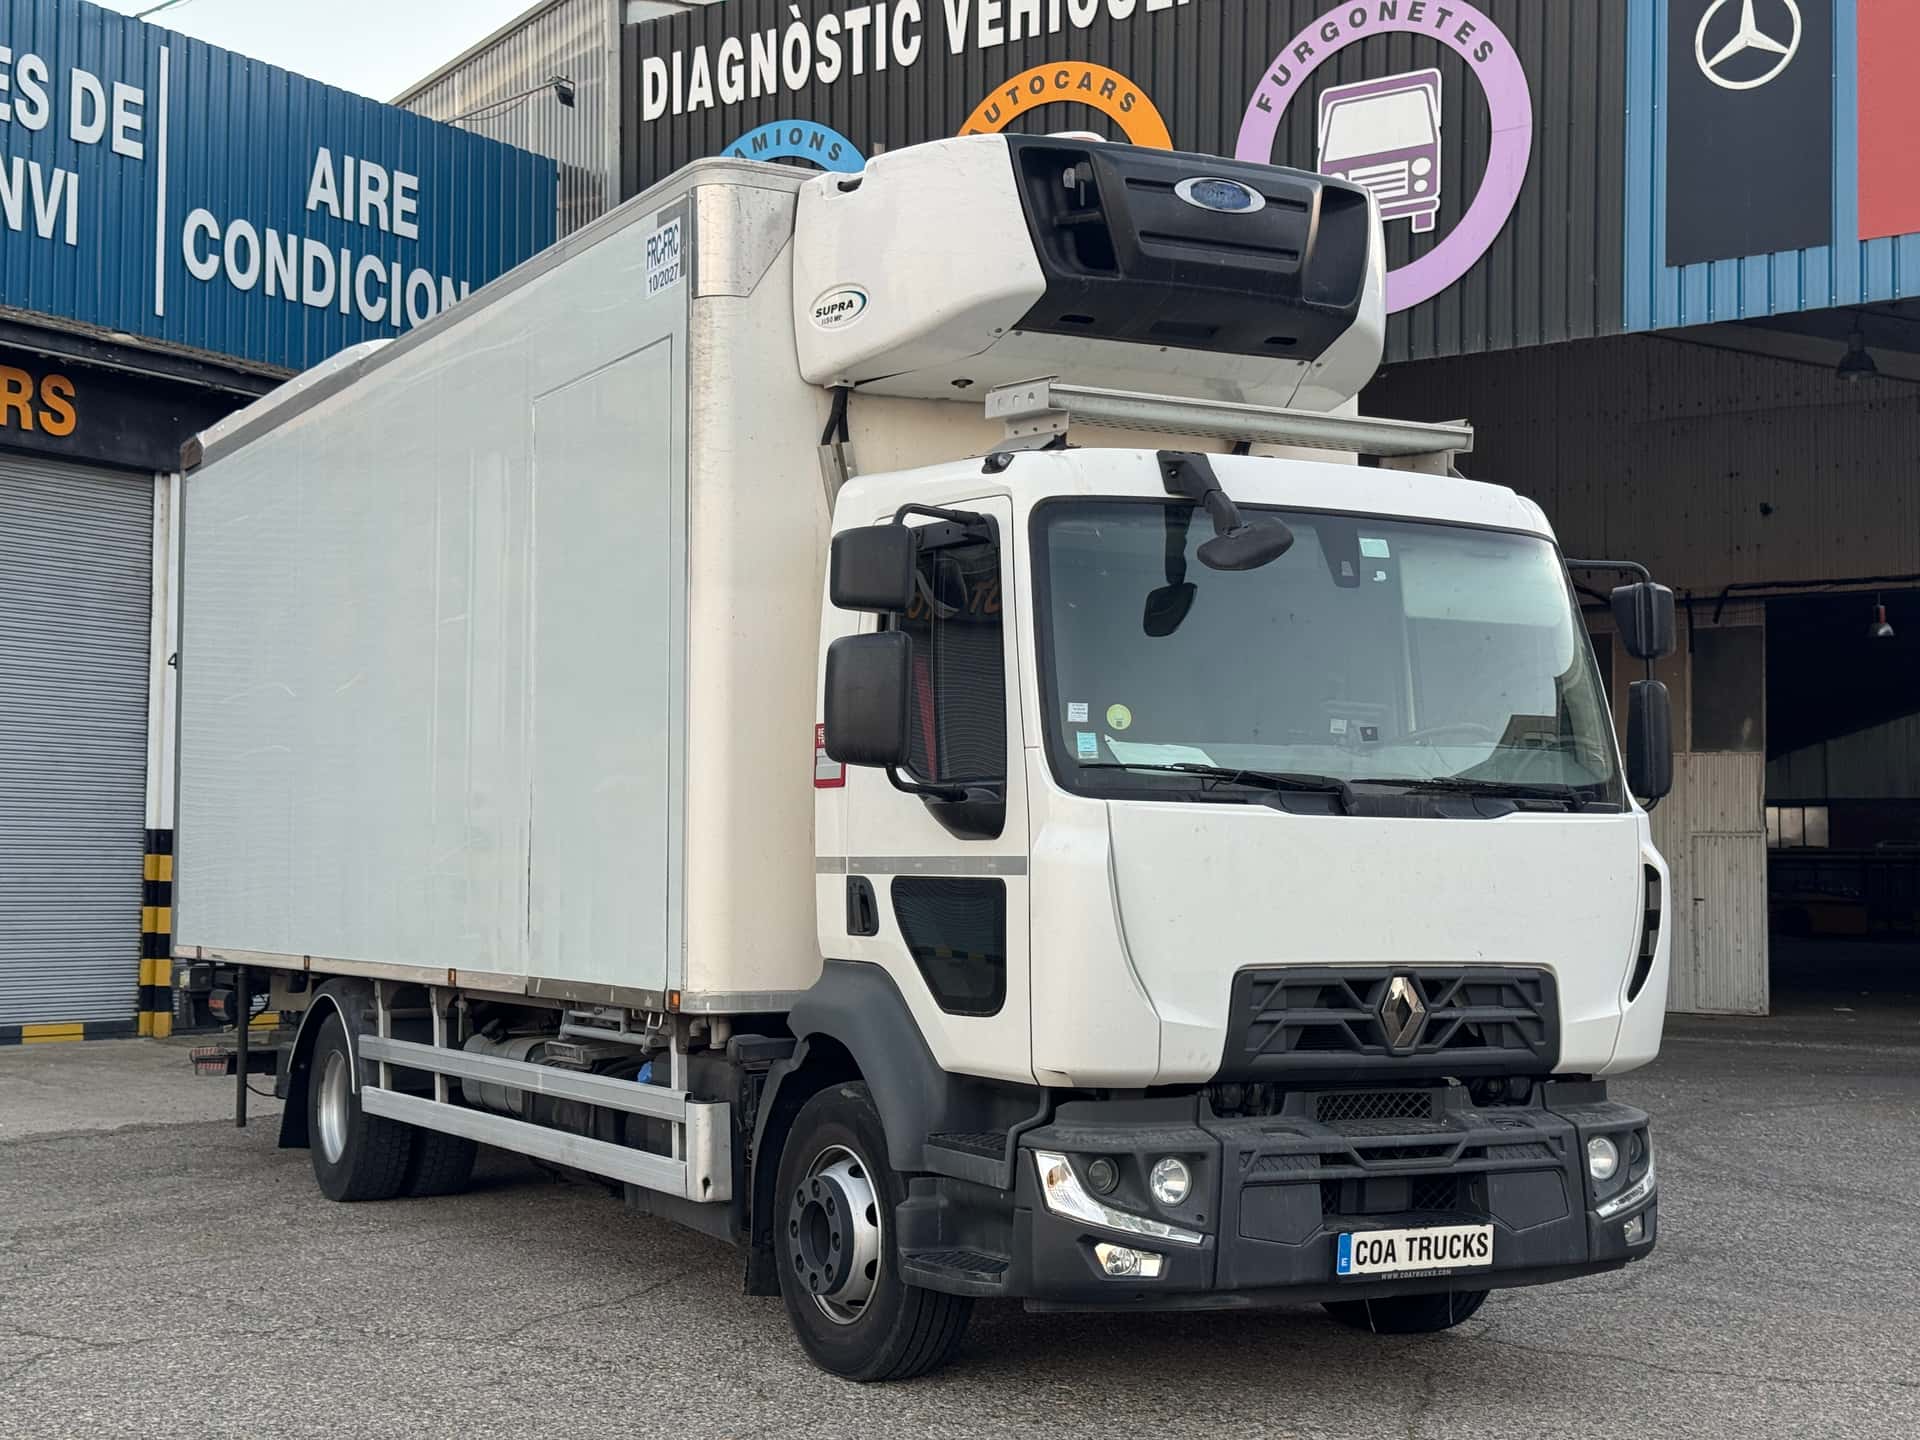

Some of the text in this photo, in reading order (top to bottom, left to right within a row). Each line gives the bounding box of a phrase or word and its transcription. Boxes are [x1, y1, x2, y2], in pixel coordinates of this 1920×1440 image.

[642, 0, 921, 121] DIAGNÒSTIC
[1256, 0, 1494, 113] FURGONETES
[70, 67, 144, 160] DE
[306, 146, 419, 240] AIRE
[648, 263, 680, 293] 10/2027
[815, 299, 854, 318] SUPRA
[0, 364, 76, 436] RS
[1341, 1232, 1489, 1267] E COA TRUCKS
